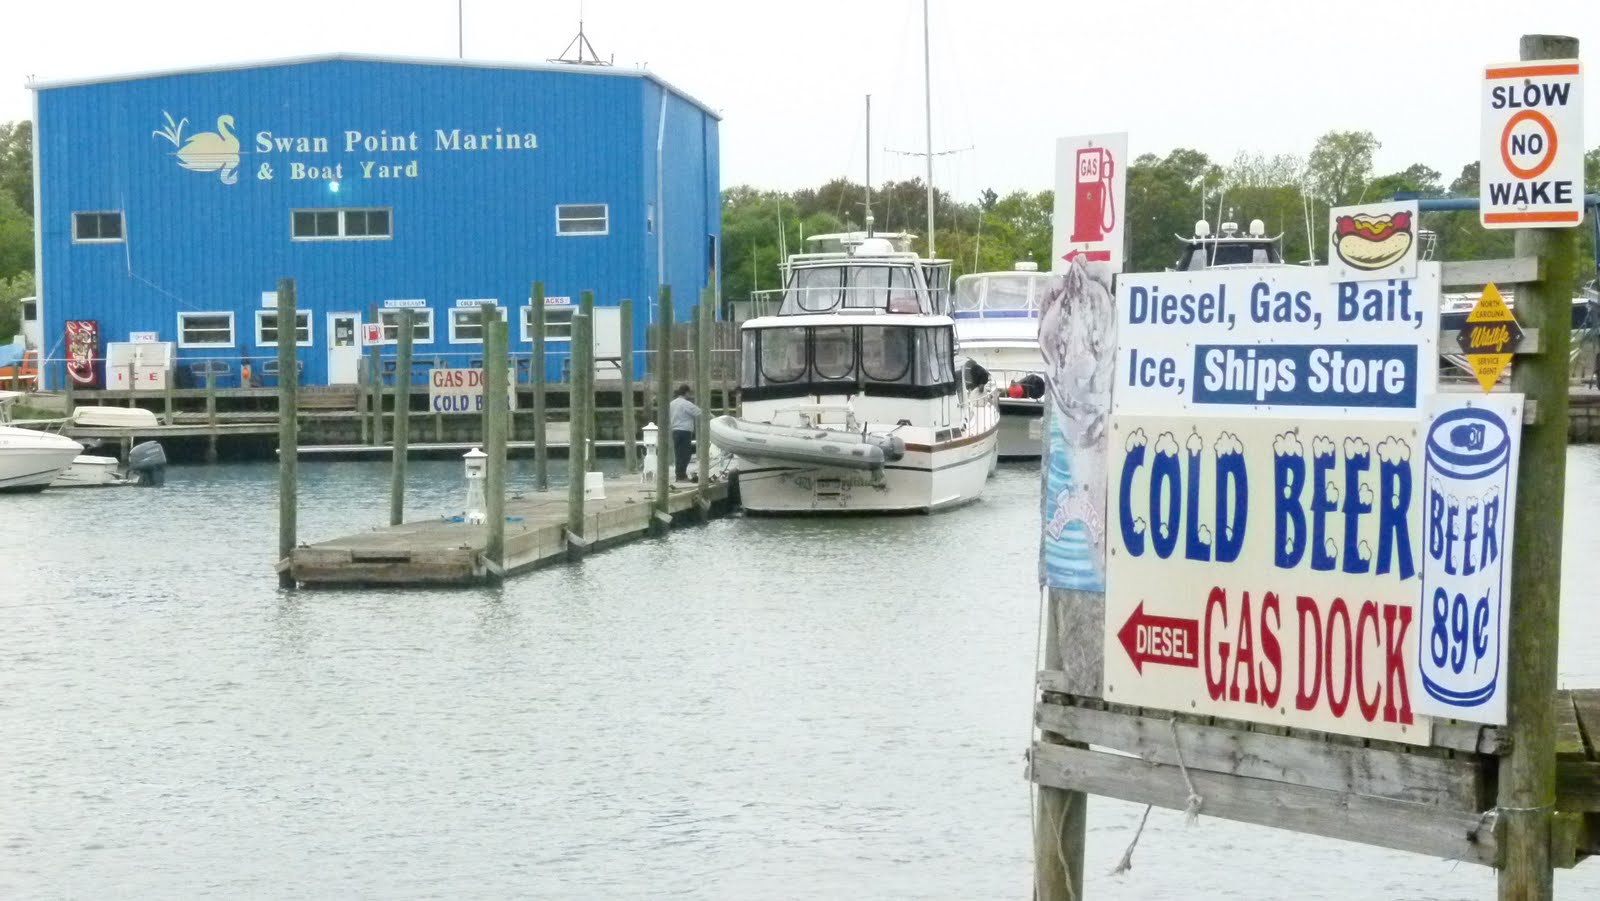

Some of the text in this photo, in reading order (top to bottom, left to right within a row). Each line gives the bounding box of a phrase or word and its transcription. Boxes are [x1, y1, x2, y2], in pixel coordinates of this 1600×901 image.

[1491, 81, 1571, 110] SLOW
[255, 127, 539, 153] Swan Point Marina
[1511, 132, 1543, 156] NO
[256, 160, 419, 181] & Boat Yard
[1080, 158, 1098, 176] GAS
[1489, 180, 1573, 206] WAKE
[1128, 279, 1424, 331] Diesel, Gas, Bait,
[1475, 309, 1505, 319] CAROLINA
[1480, 300, 1500, 309] NORTH
[1470, 324, 1511, 353] Wildlife
[1478, 356, 1500, 365] SERVICE
[1478, 367, 1498, 376] AGENT
[433, 370, 464, 388] GAS
[1128, 348, 1406, 401] Ice, Ships Store
[433, 394, 470, 412] COLD
[1118, 427, 1249, 563] COLD
[1272, 430, 1416, 582] BEER
[1429, 476, 1500, 577] BEER
[1430, 586, 1491, 675] 89¢
[1135, 585, 1414, 726] DIESEL GAS DOCK
